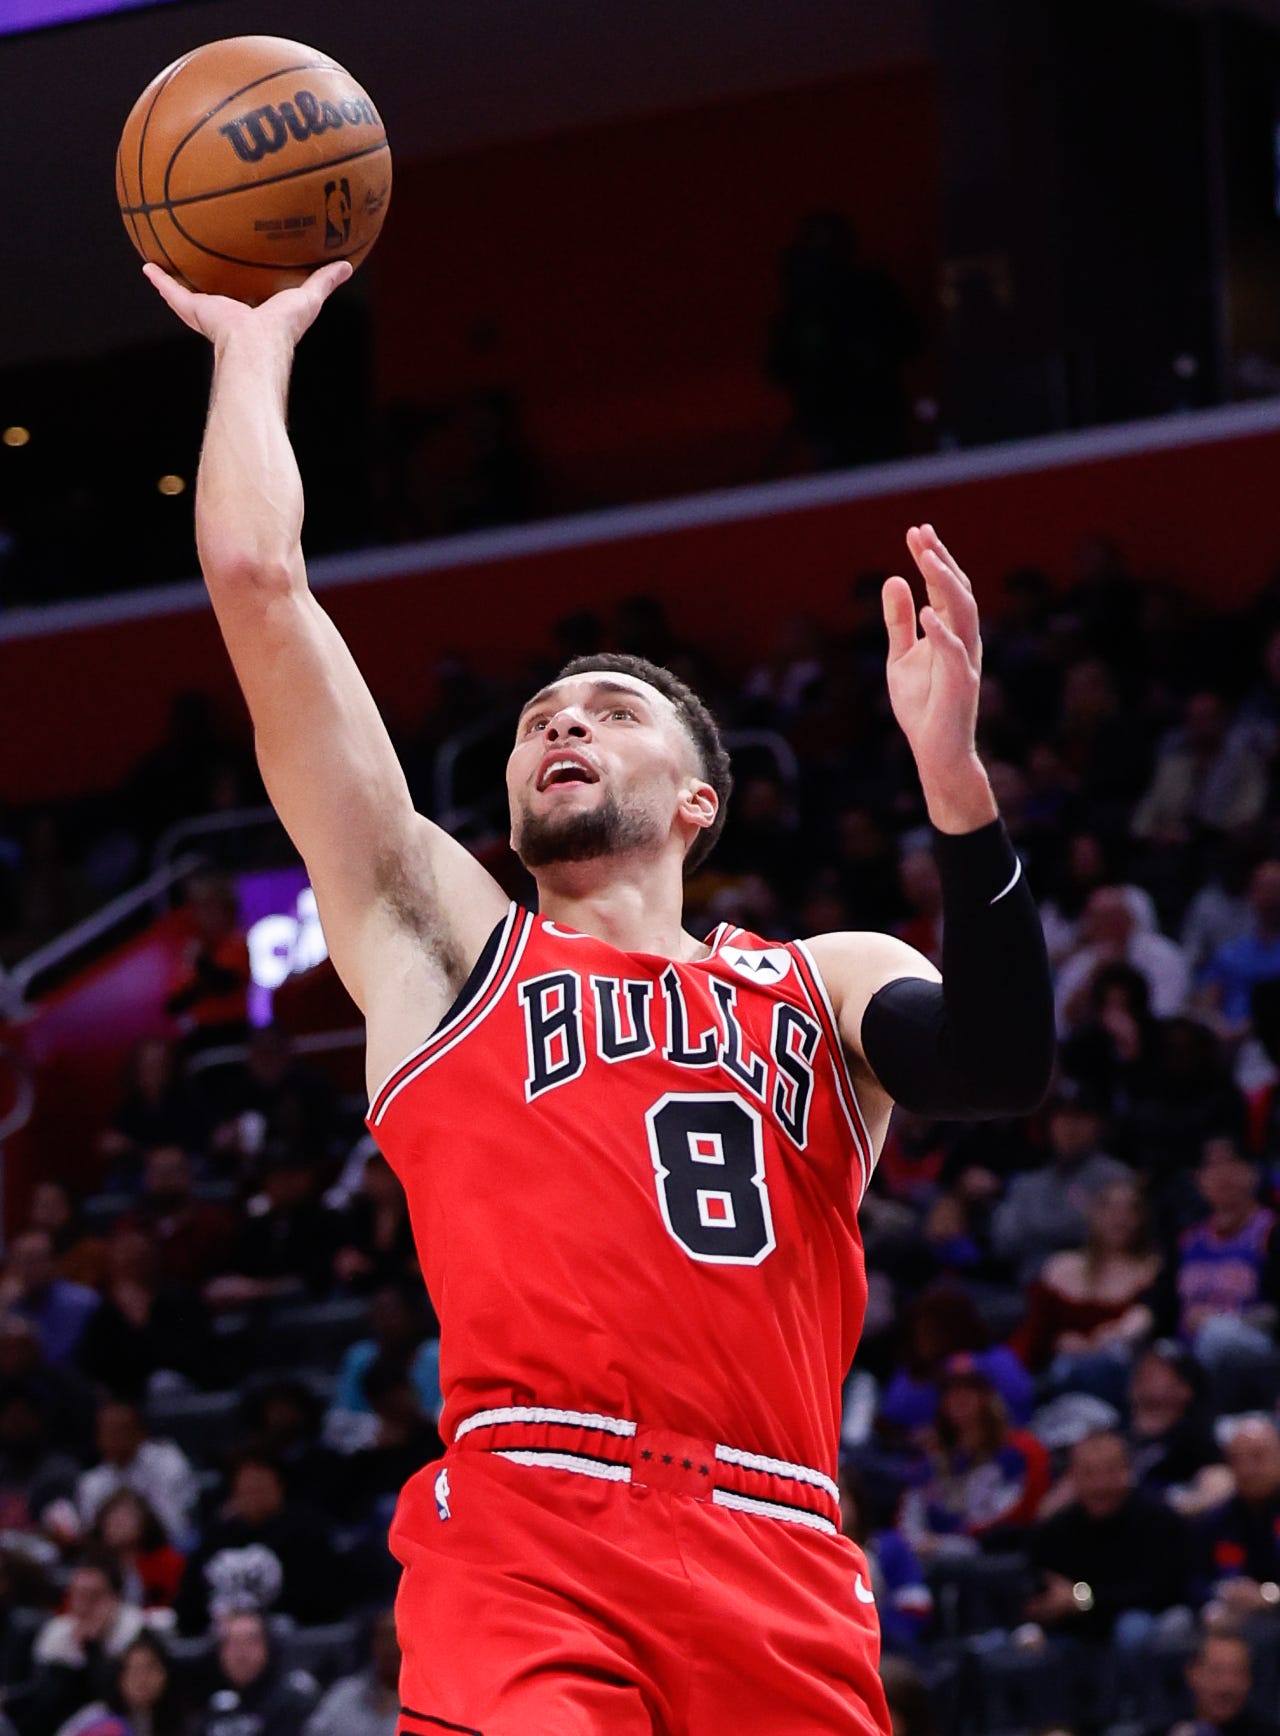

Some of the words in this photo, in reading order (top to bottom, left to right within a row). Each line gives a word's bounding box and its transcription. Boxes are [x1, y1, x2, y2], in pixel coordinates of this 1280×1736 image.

[218, 90, 380, 163] Wilson
[517, 962, 823, 1151] BULLS
[644, 1091, 777, 1267] 8
